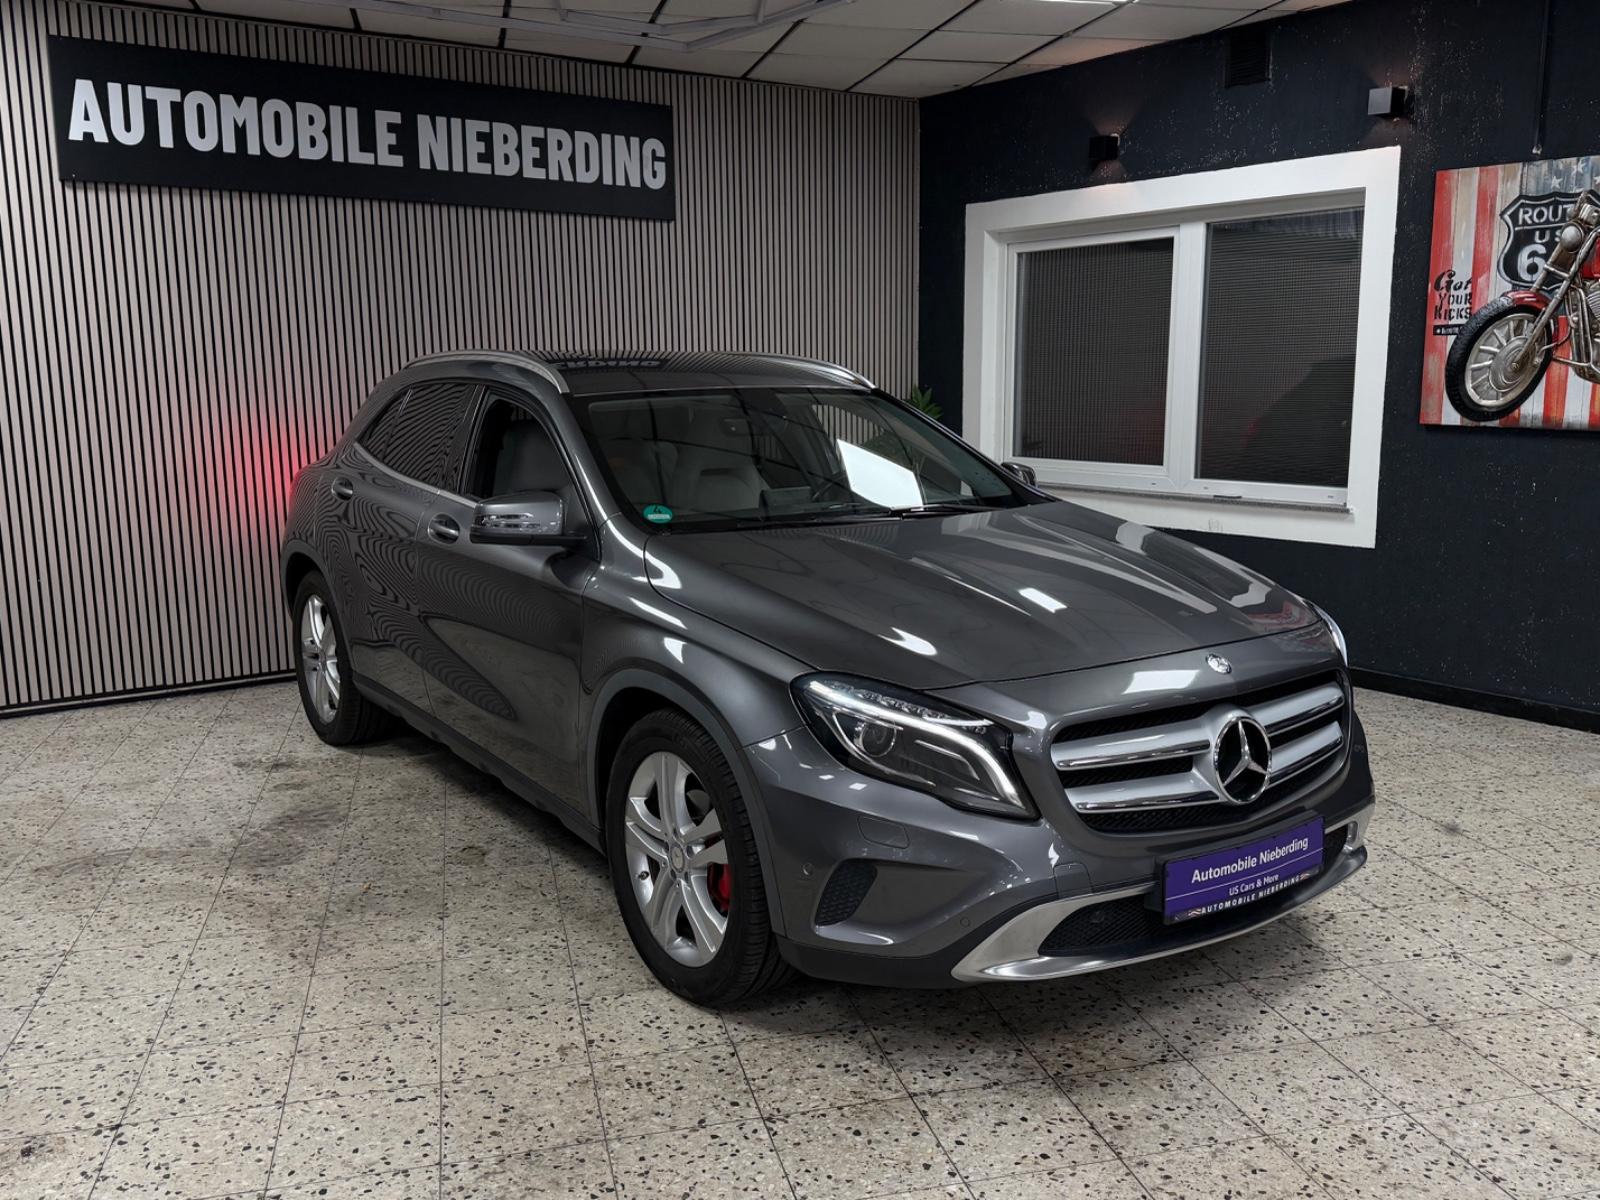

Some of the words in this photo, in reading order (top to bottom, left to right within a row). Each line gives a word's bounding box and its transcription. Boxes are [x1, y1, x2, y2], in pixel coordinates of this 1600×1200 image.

[68, 78, 403, 168] AUTOMOBILE
[417, 114, 668, 190] NIEBERDING
[1518, 204, 1576, 225] ROUT
[1433, 305, 1473, 321] KICKS
[1438, 292, 1473, 311] YOUR
[1192, 856, 1257, 884] Automobile
[1259, 837, 1309, 866] Nieberding
[1201, 893, 1256, 914] AUTOMOBILE
[1258, 875, 1300, 898] NIEBERDING
[1229, 885, 1239, 896] US
[1240, 881, 1256, 893] Cars
[1256, 878, 1263, 888] &
[1263, 873, 1280, 885] More
